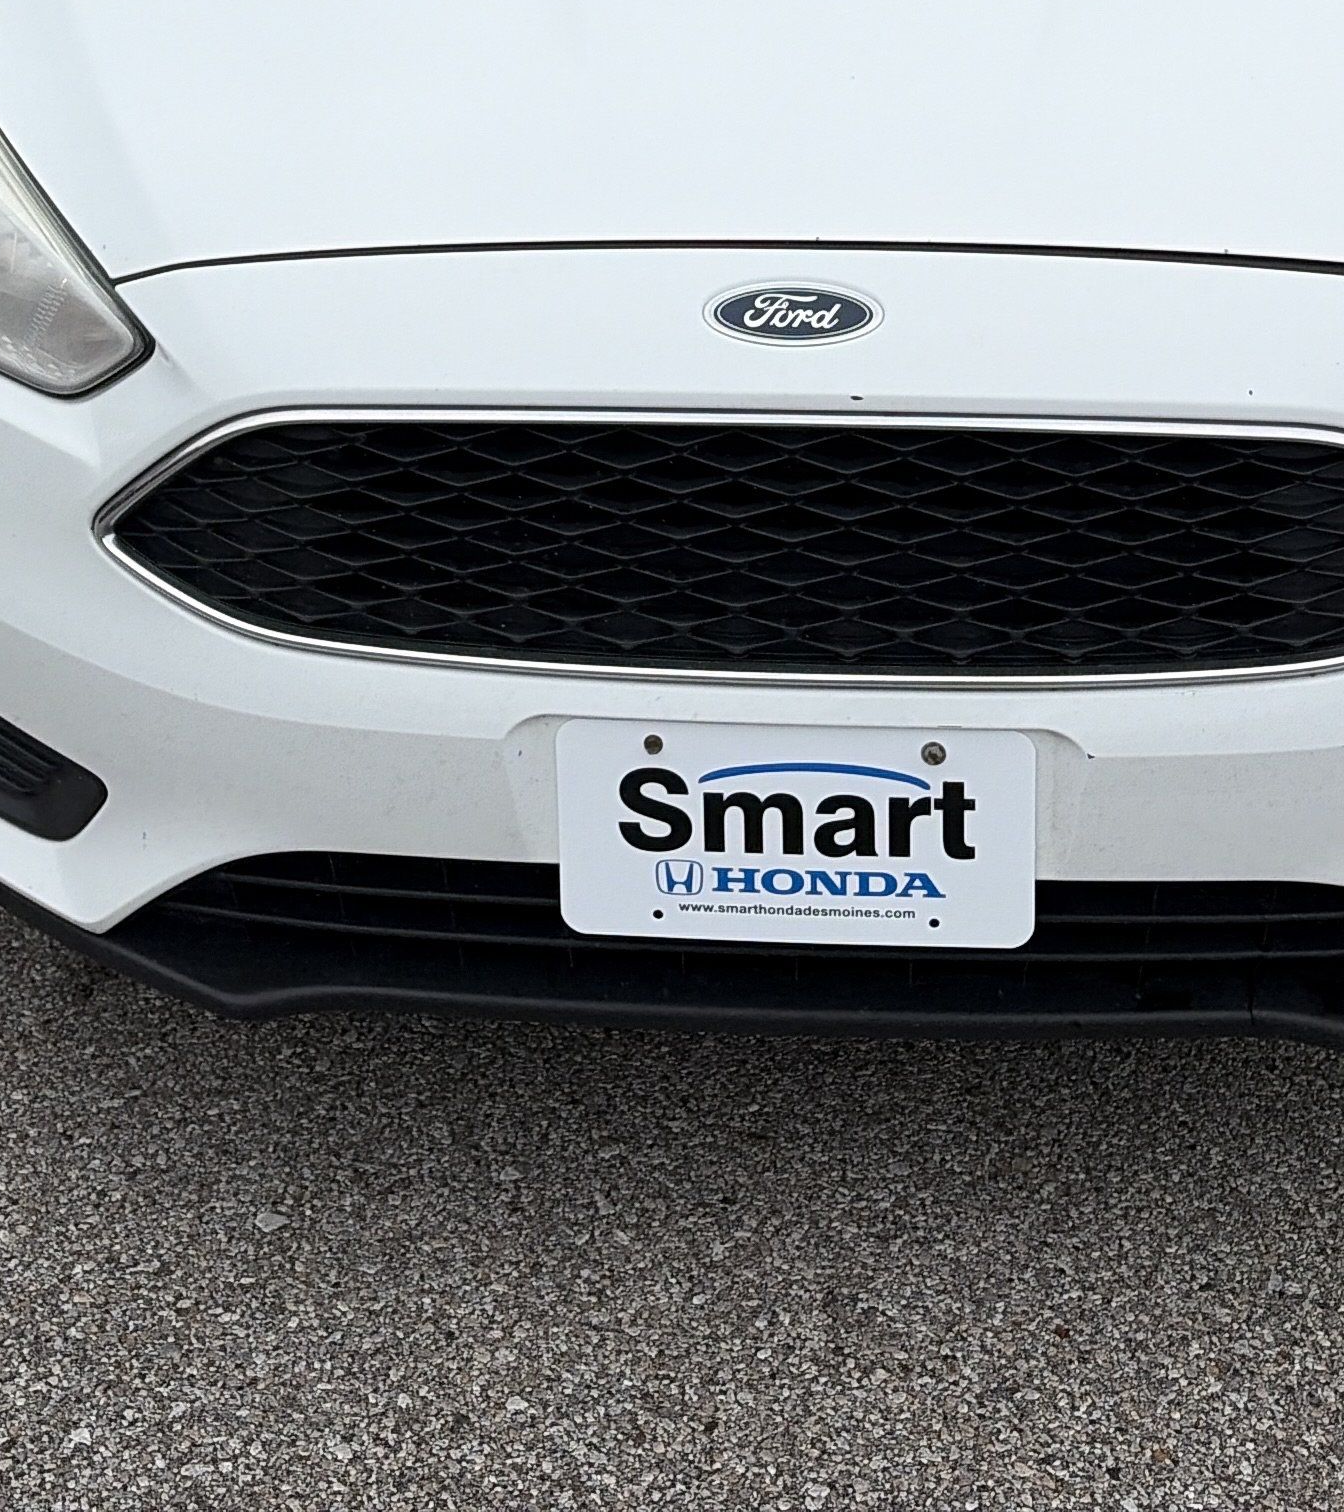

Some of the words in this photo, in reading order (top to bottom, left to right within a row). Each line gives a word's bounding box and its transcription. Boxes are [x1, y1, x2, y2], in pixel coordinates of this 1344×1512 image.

[743, 293, 842, 329] Ford
[618, 767, 976, 860] Smart
[712, 867, 946, 898] HONDA
[678, 901, 916, 920] www.smarthondadesmoines.com
